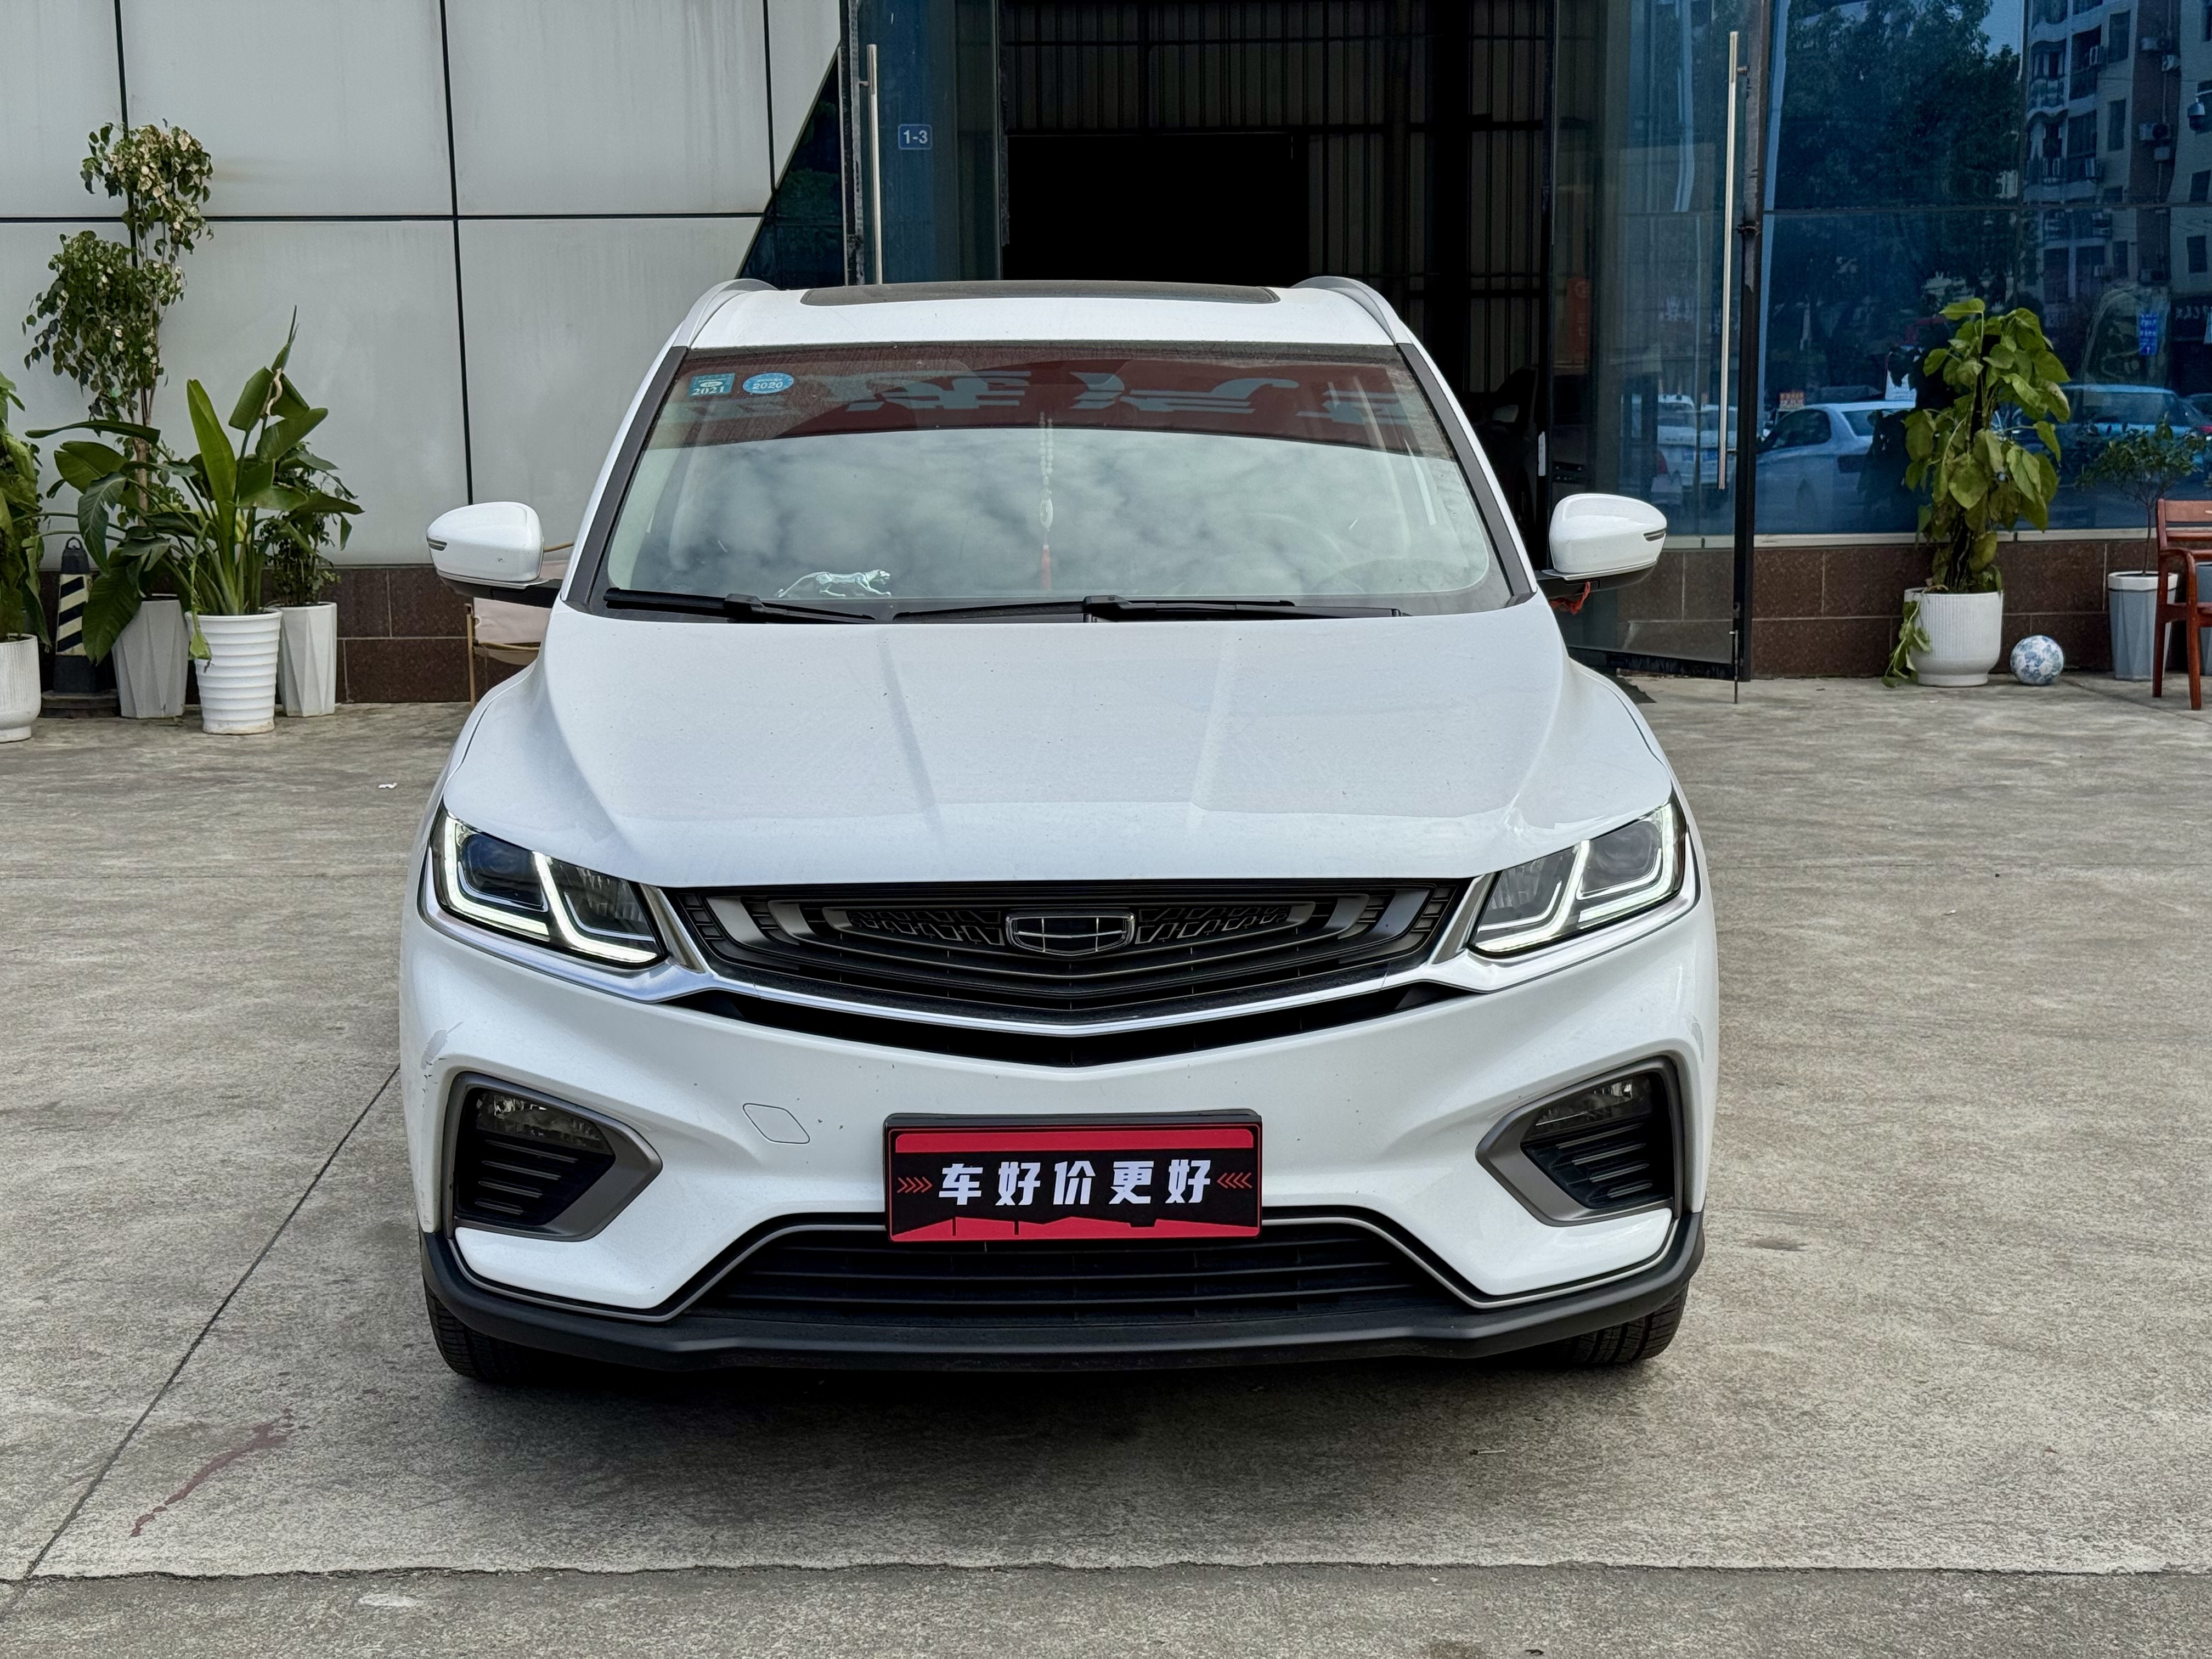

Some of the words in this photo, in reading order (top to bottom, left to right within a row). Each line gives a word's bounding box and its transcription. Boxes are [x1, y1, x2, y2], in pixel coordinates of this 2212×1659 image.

[903, 129, 928, 144] 1-3
[691, 386, 725, 396] 2021
[752, 381, 783, 390] 2020
[938, 1159, 1212, 1206] 车好价更好
